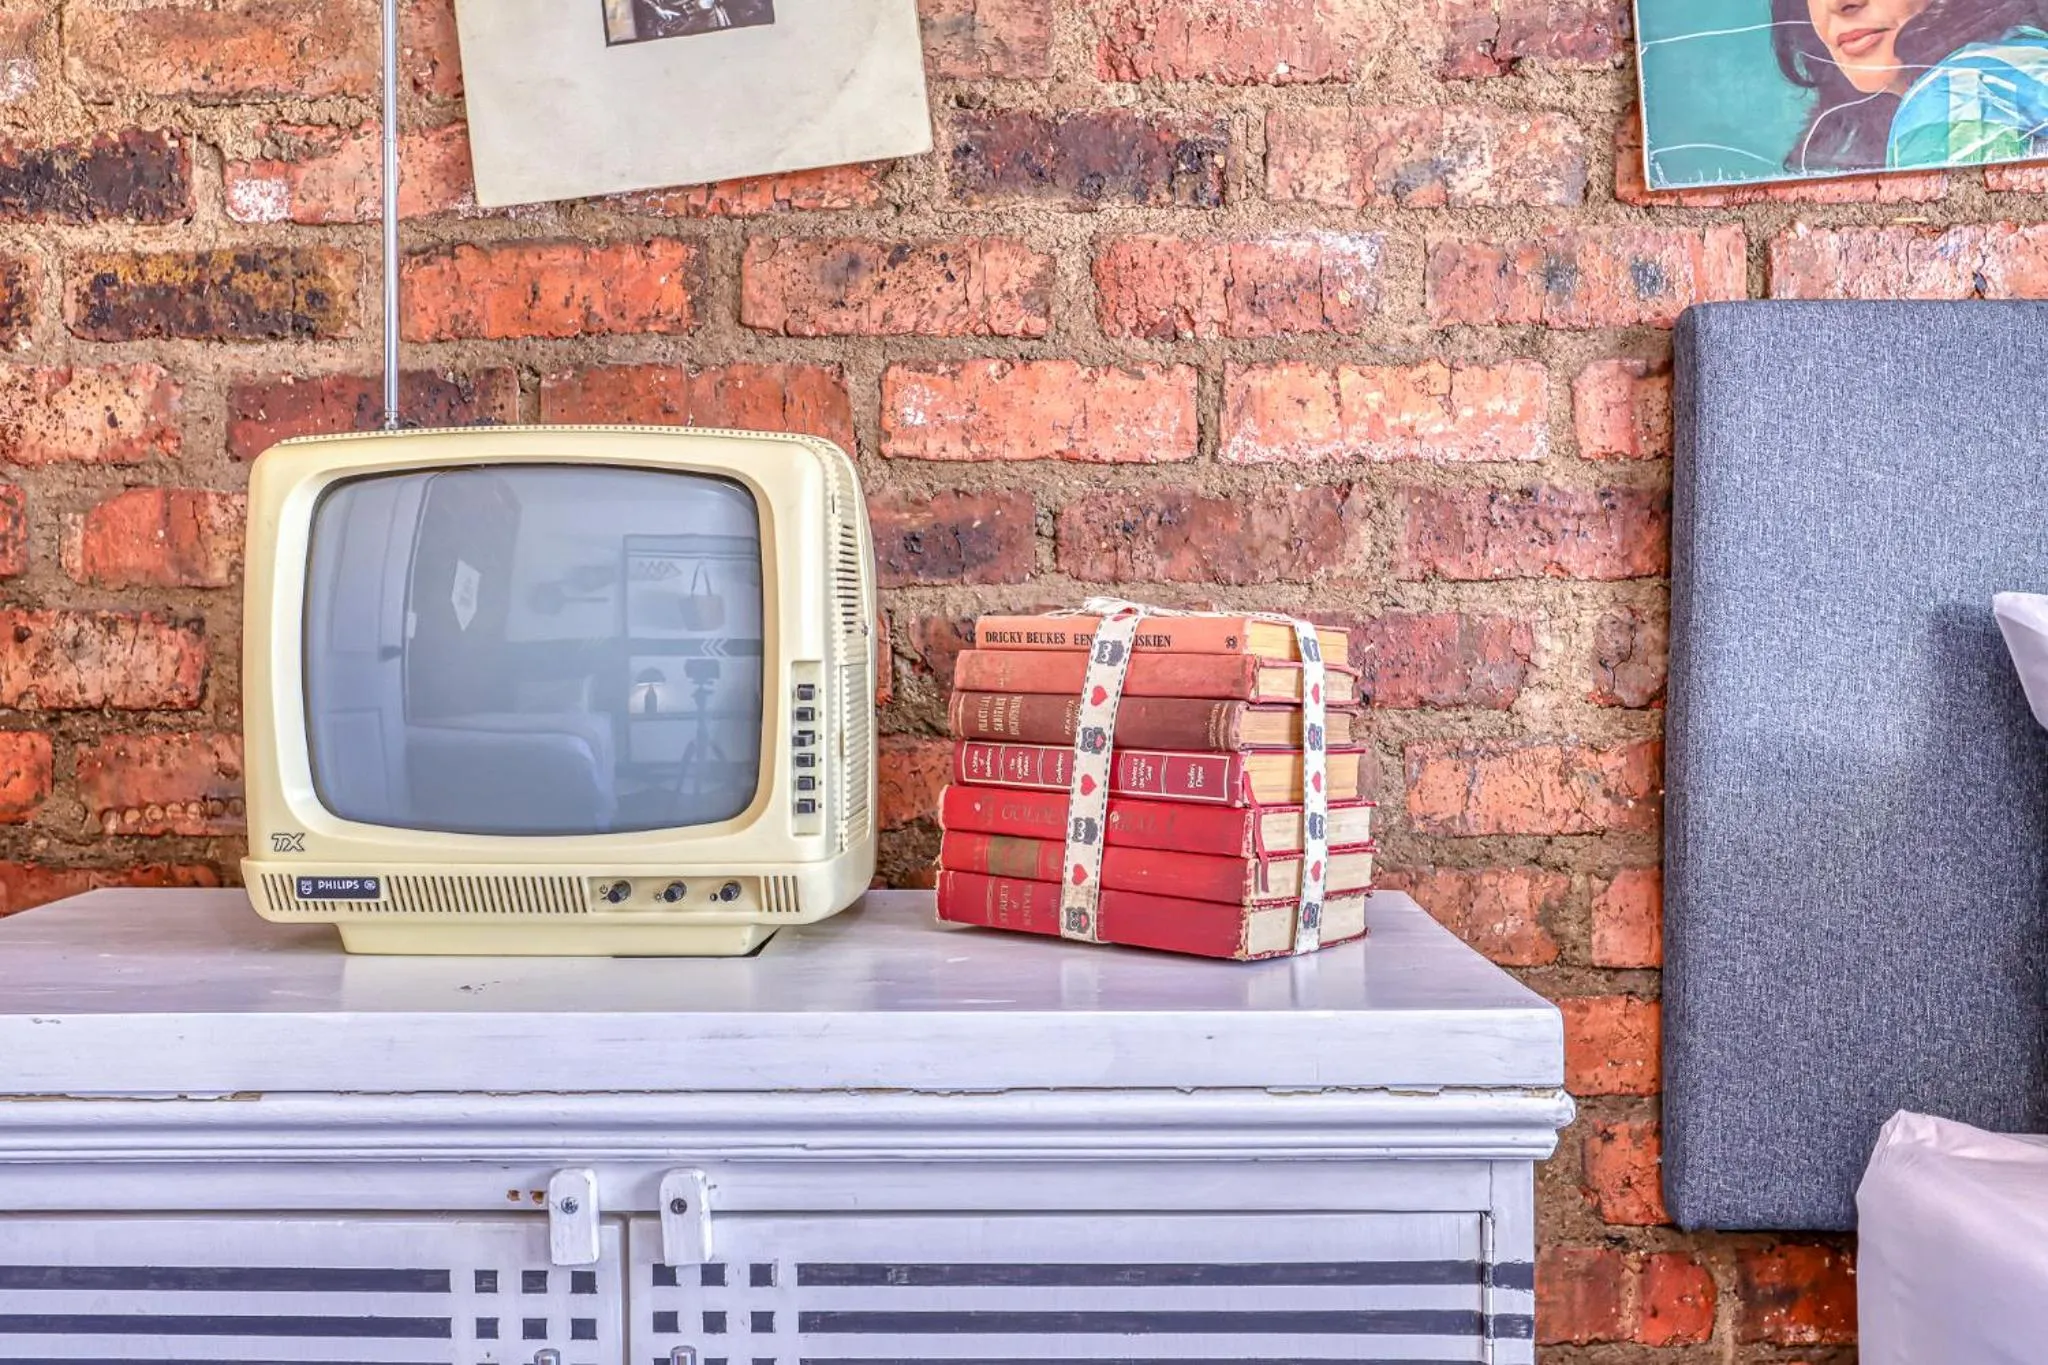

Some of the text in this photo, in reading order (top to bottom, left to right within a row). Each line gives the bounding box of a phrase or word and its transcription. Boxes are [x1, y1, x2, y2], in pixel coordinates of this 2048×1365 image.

[985, 631, 1023, 644] DRICKY
[1026, 631, 1066, 645] BEUKES
[1131, 634, 1172, 648] ISKIEN
[270, 831, 306, 853] TX
[317, 879, 360, 890] PHILIPS
